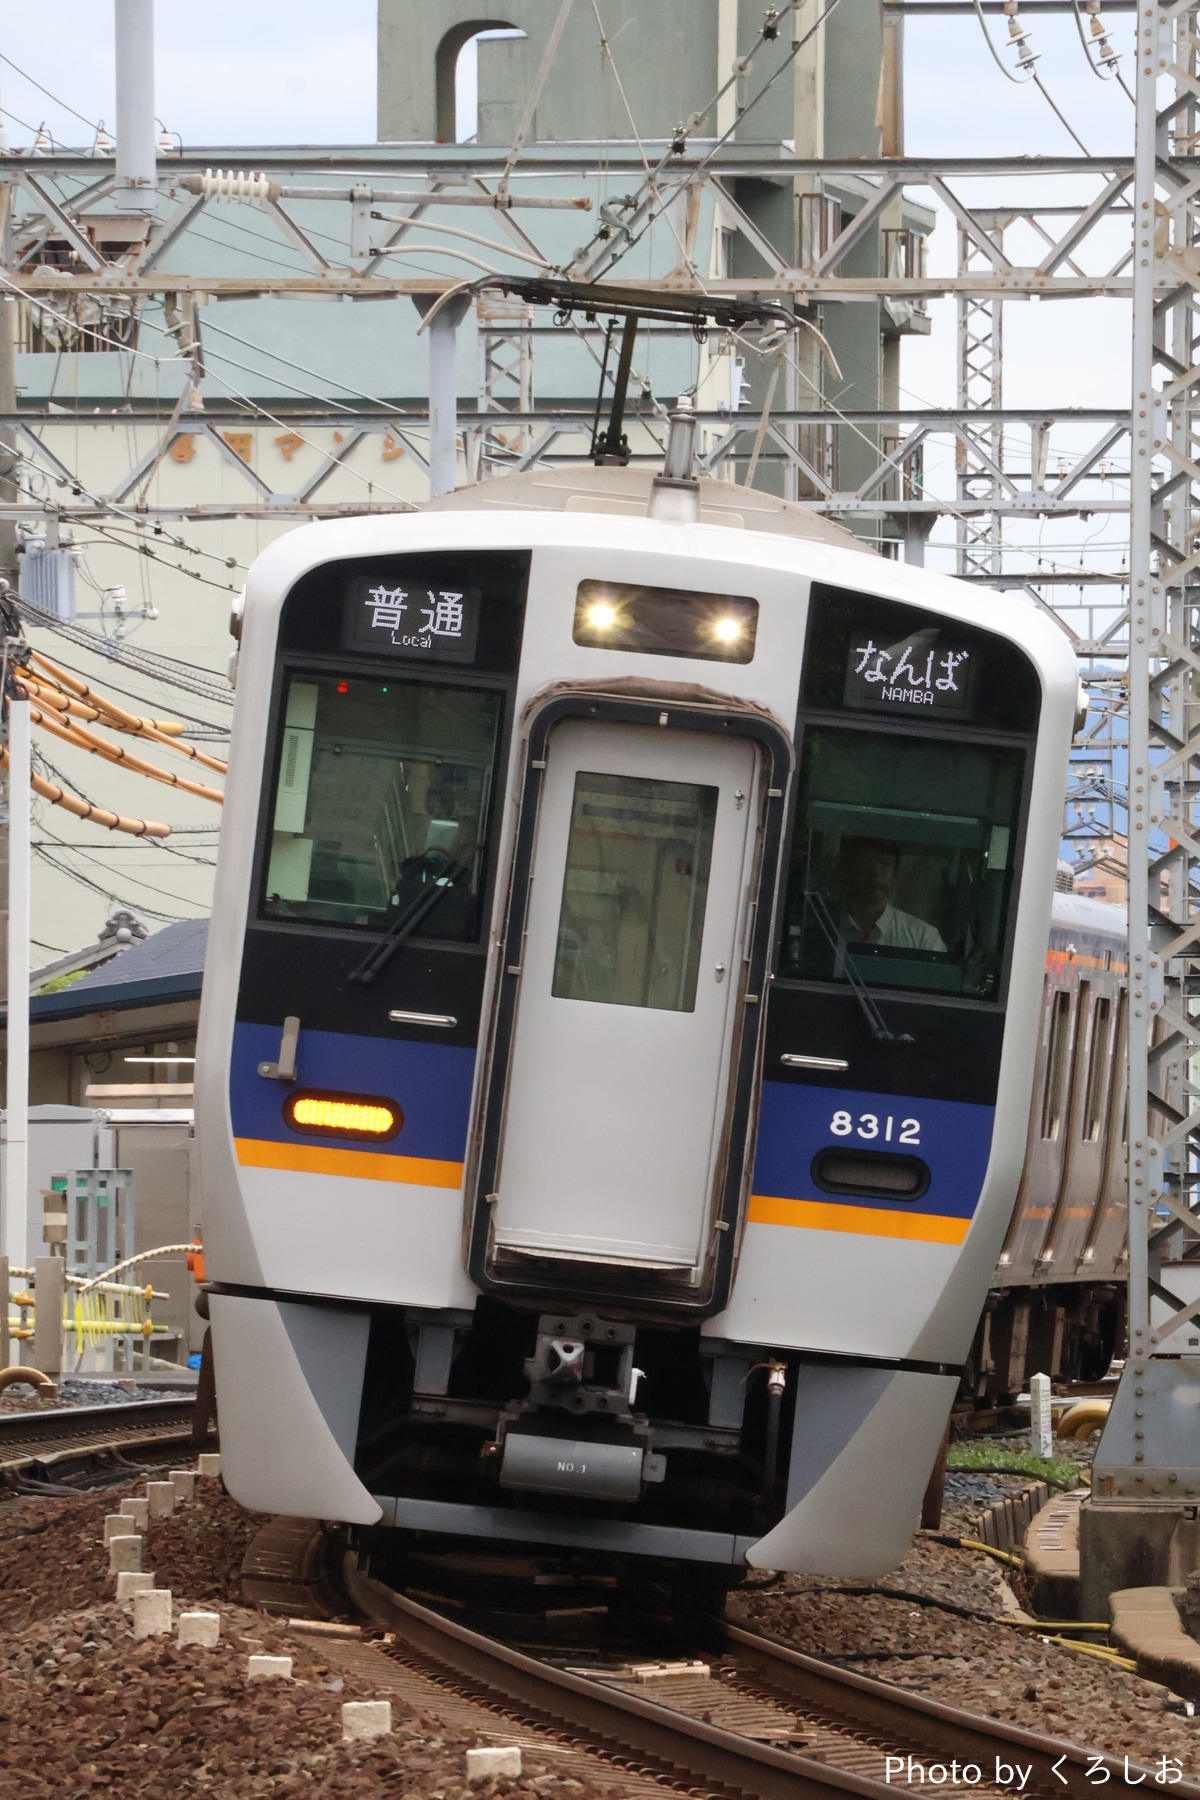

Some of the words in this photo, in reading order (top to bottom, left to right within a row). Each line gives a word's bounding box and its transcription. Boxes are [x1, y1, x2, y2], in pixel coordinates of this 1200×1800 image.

[364, 585, 464, 637] 普通
[390, 630, 432, 649] Local
[855, 640, 970, 691] なんば
[881, 686, 934, 705] NAMBA
[829, 1110, 921, 1145] 8312
